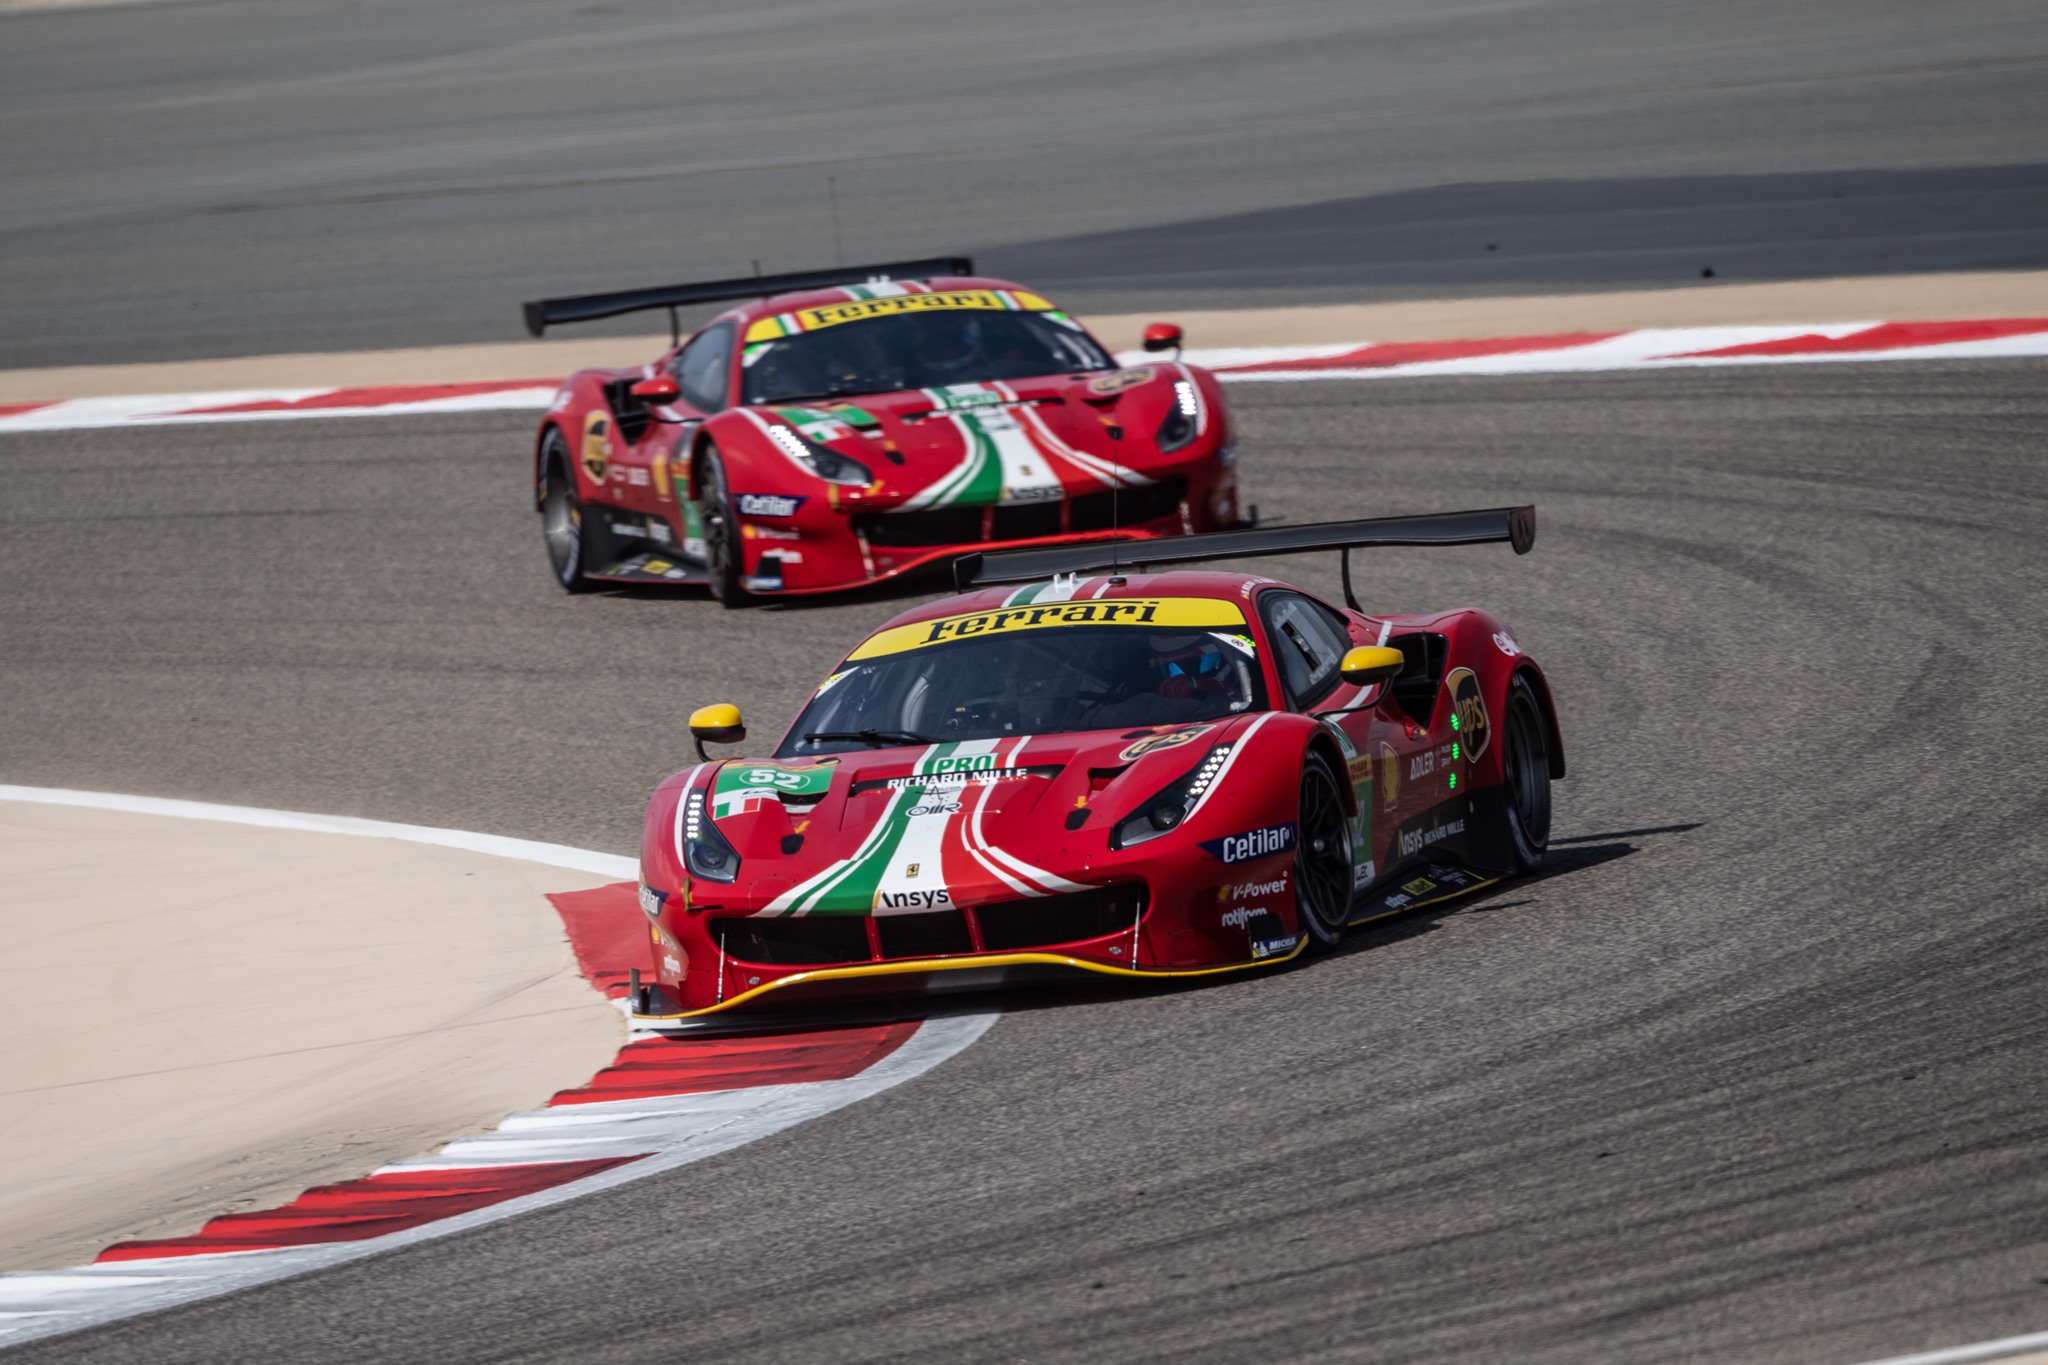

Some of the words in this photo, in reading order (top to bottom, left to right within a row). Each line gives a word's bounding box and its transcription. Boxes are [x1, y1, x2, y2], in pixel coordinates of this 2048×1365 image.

[812, 292, 995, 323] Ferrari
[919, 601, 1159, 644] Ferrari
[936, 754, 993, 774] PRO
[1410, 751, 1434, 781] ADLER
[749, 769, 801, 789] 52
[887, 772, 966, 790] RICHARD
[1223, 827, 1287, 863] Cetilar
[873, 888, 949, 909] Ansys
[1233, 879, 1287, 900] V-Power
